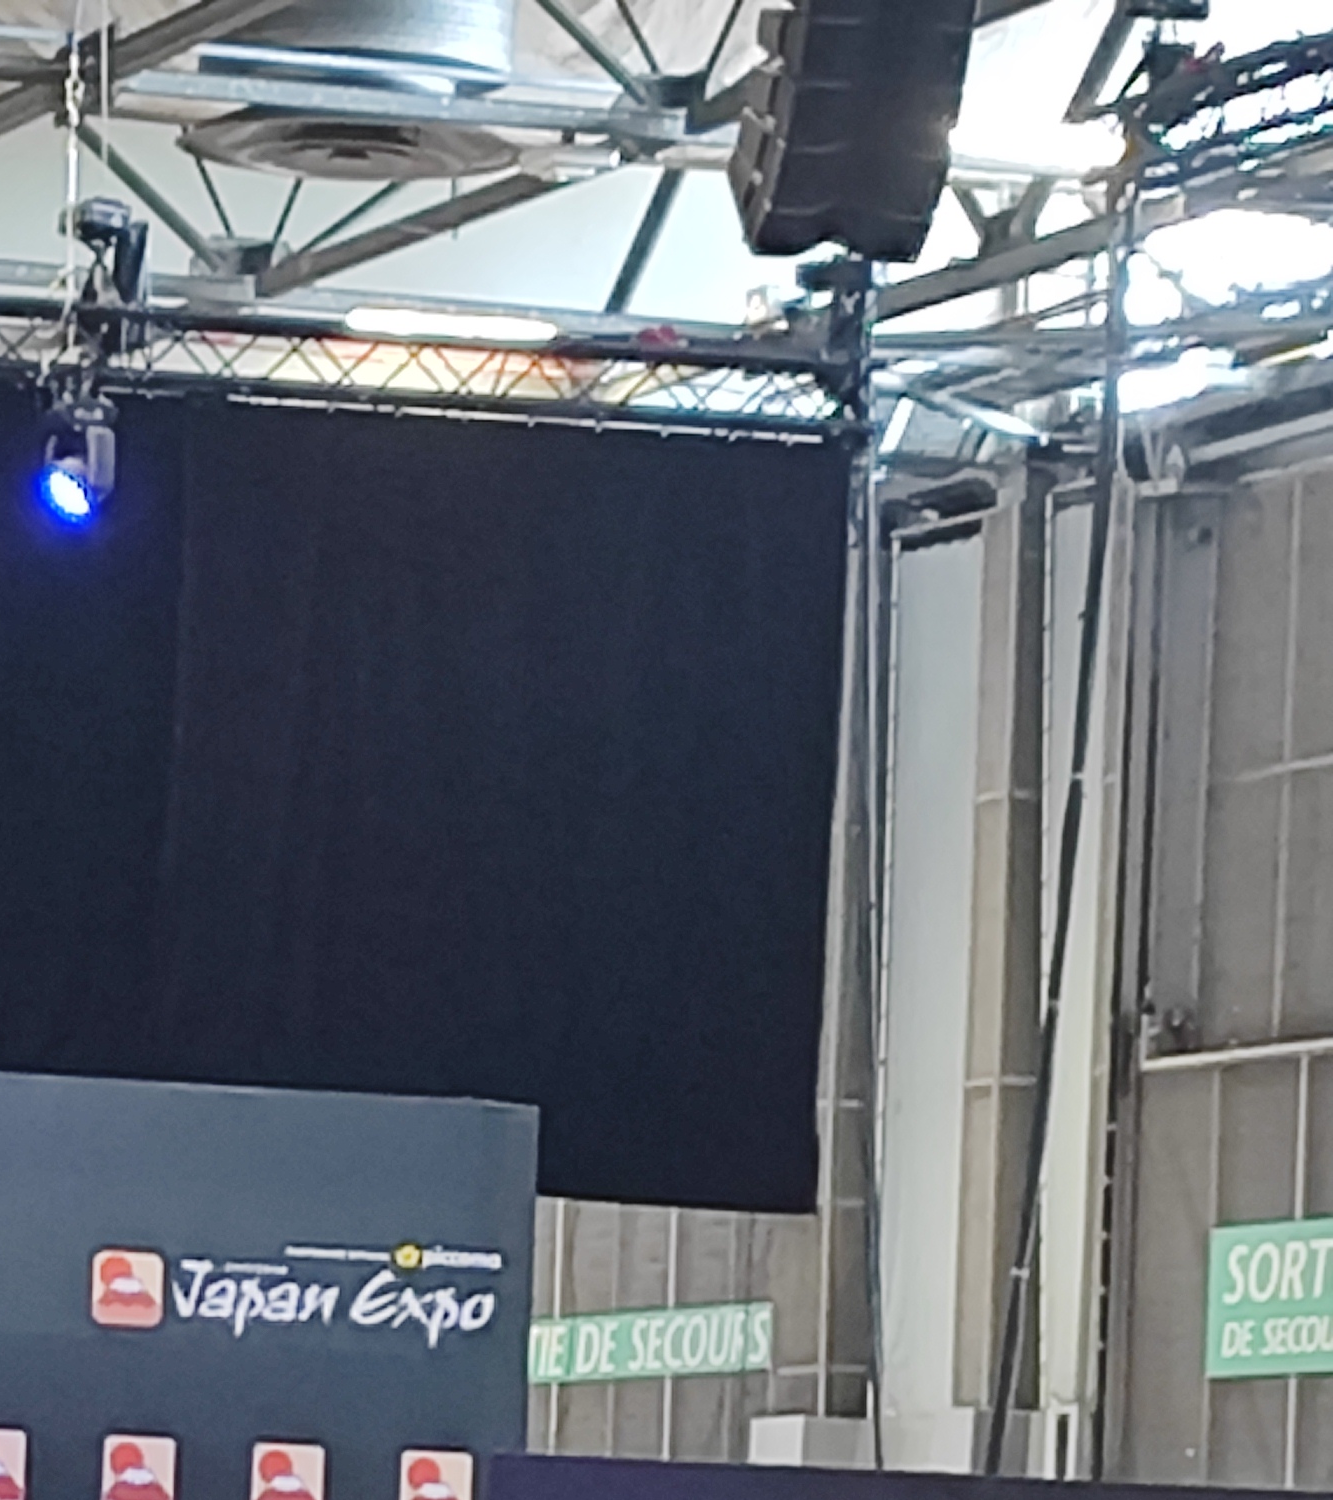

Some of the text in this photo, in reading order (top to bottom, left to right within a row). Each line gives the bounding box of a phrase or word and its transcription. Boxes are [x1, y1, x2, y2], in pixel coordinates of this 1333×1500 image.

[1221, 1237, 1333, 1305] SORT
[171, 1259, 496, 1349] Japan Expo
[575, 1320, 620, 1374] DE
[1220, 1319, 1256, 1359] DE
